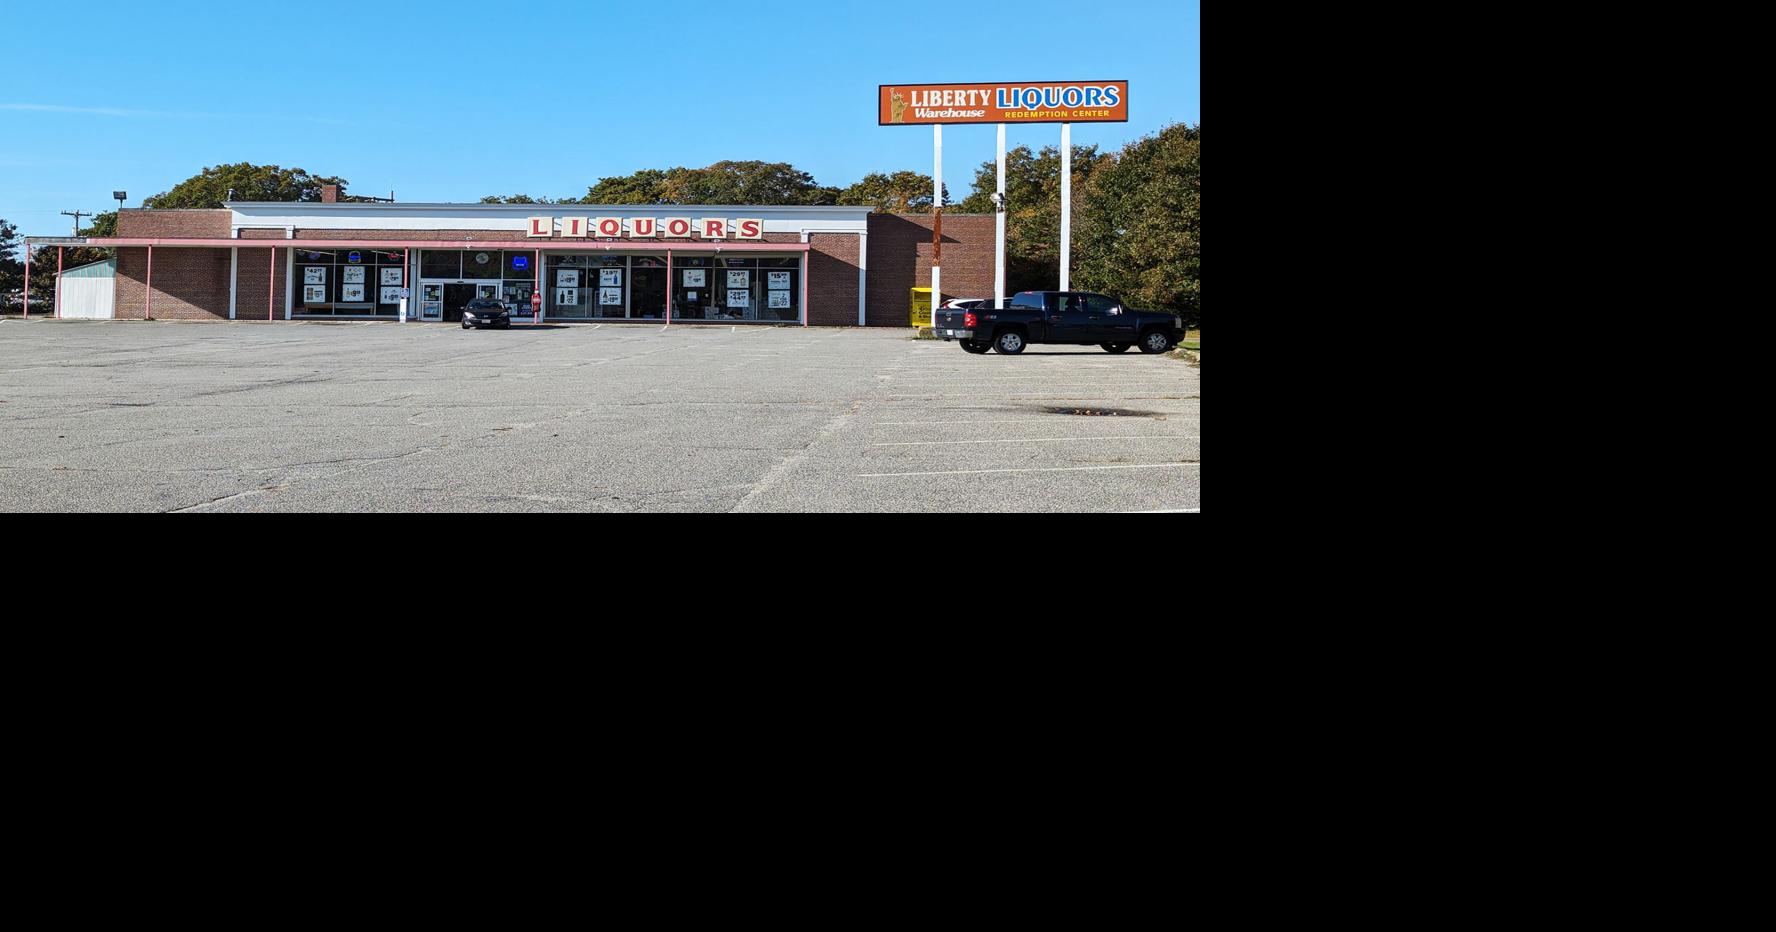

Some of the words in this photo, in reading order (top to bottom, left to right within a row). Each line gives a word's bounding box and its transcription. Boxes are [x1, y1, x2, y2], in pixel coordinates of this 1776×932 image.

[910, 89, 992, 107] LIBERTY
[996, 85, 1120, 110] LIQUORS
[914, 108, 985, 118] Warehouse
[1005, 110, 1068, 118] REDEMPTION
[1072, 109, 1110, 117] CENTER
[532, 219, 759, 237] LIQUORS
